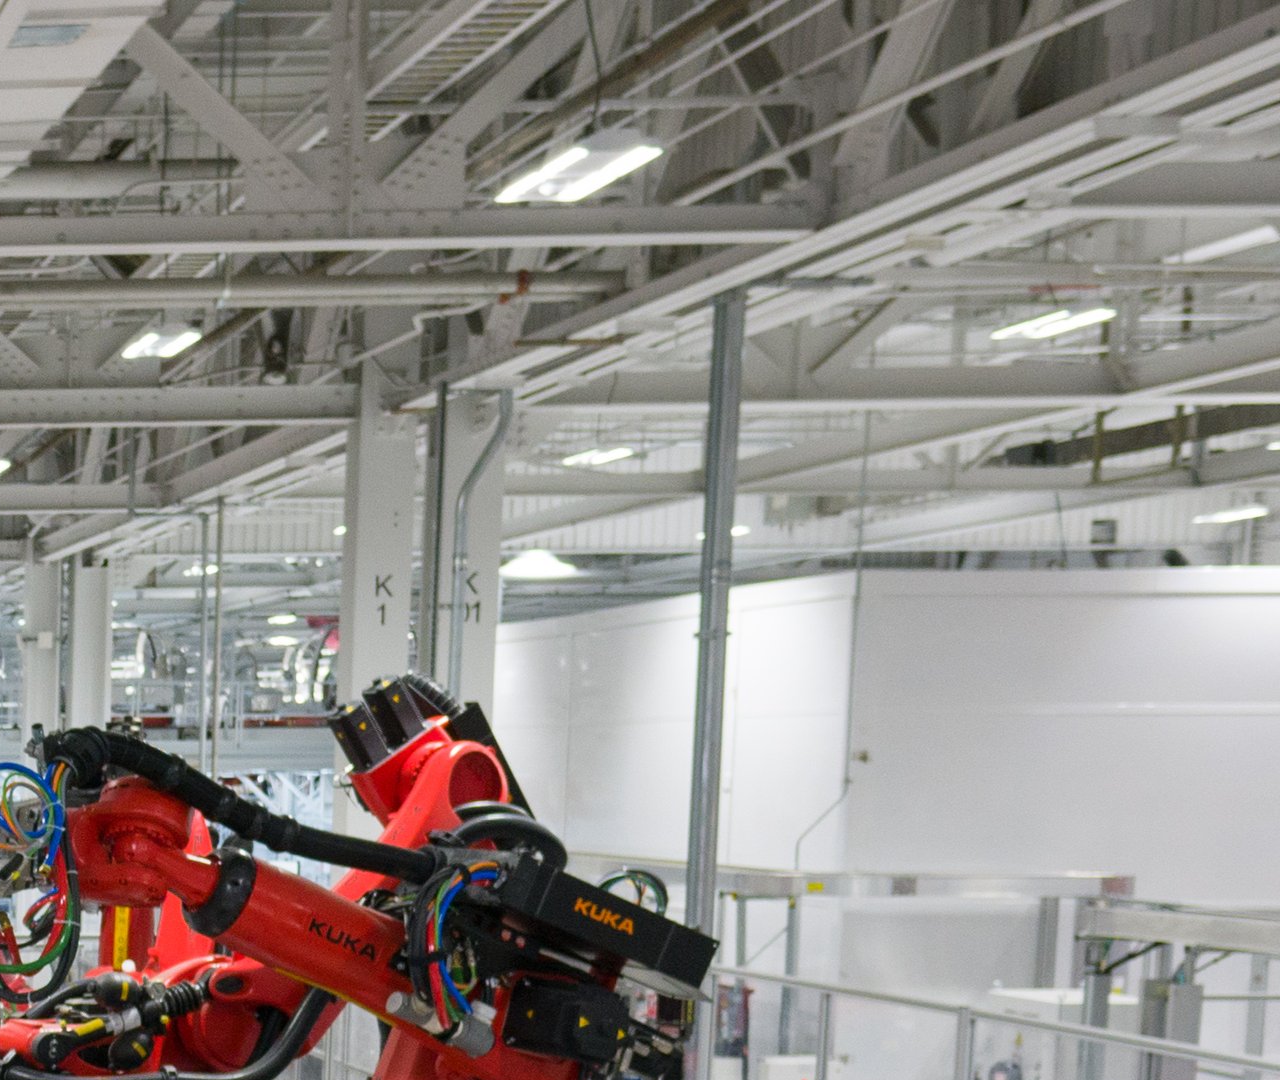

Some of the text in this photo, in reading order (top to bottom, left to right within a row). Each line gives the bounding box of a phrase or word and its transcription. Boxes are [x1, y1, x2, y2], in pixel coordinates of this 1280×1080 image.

[375, 575, 393, 597] K
[377, 603, 386, 625] 1
[573, 896, 635, 937] KUKA
[308, 917, 376, 961] KUKA
